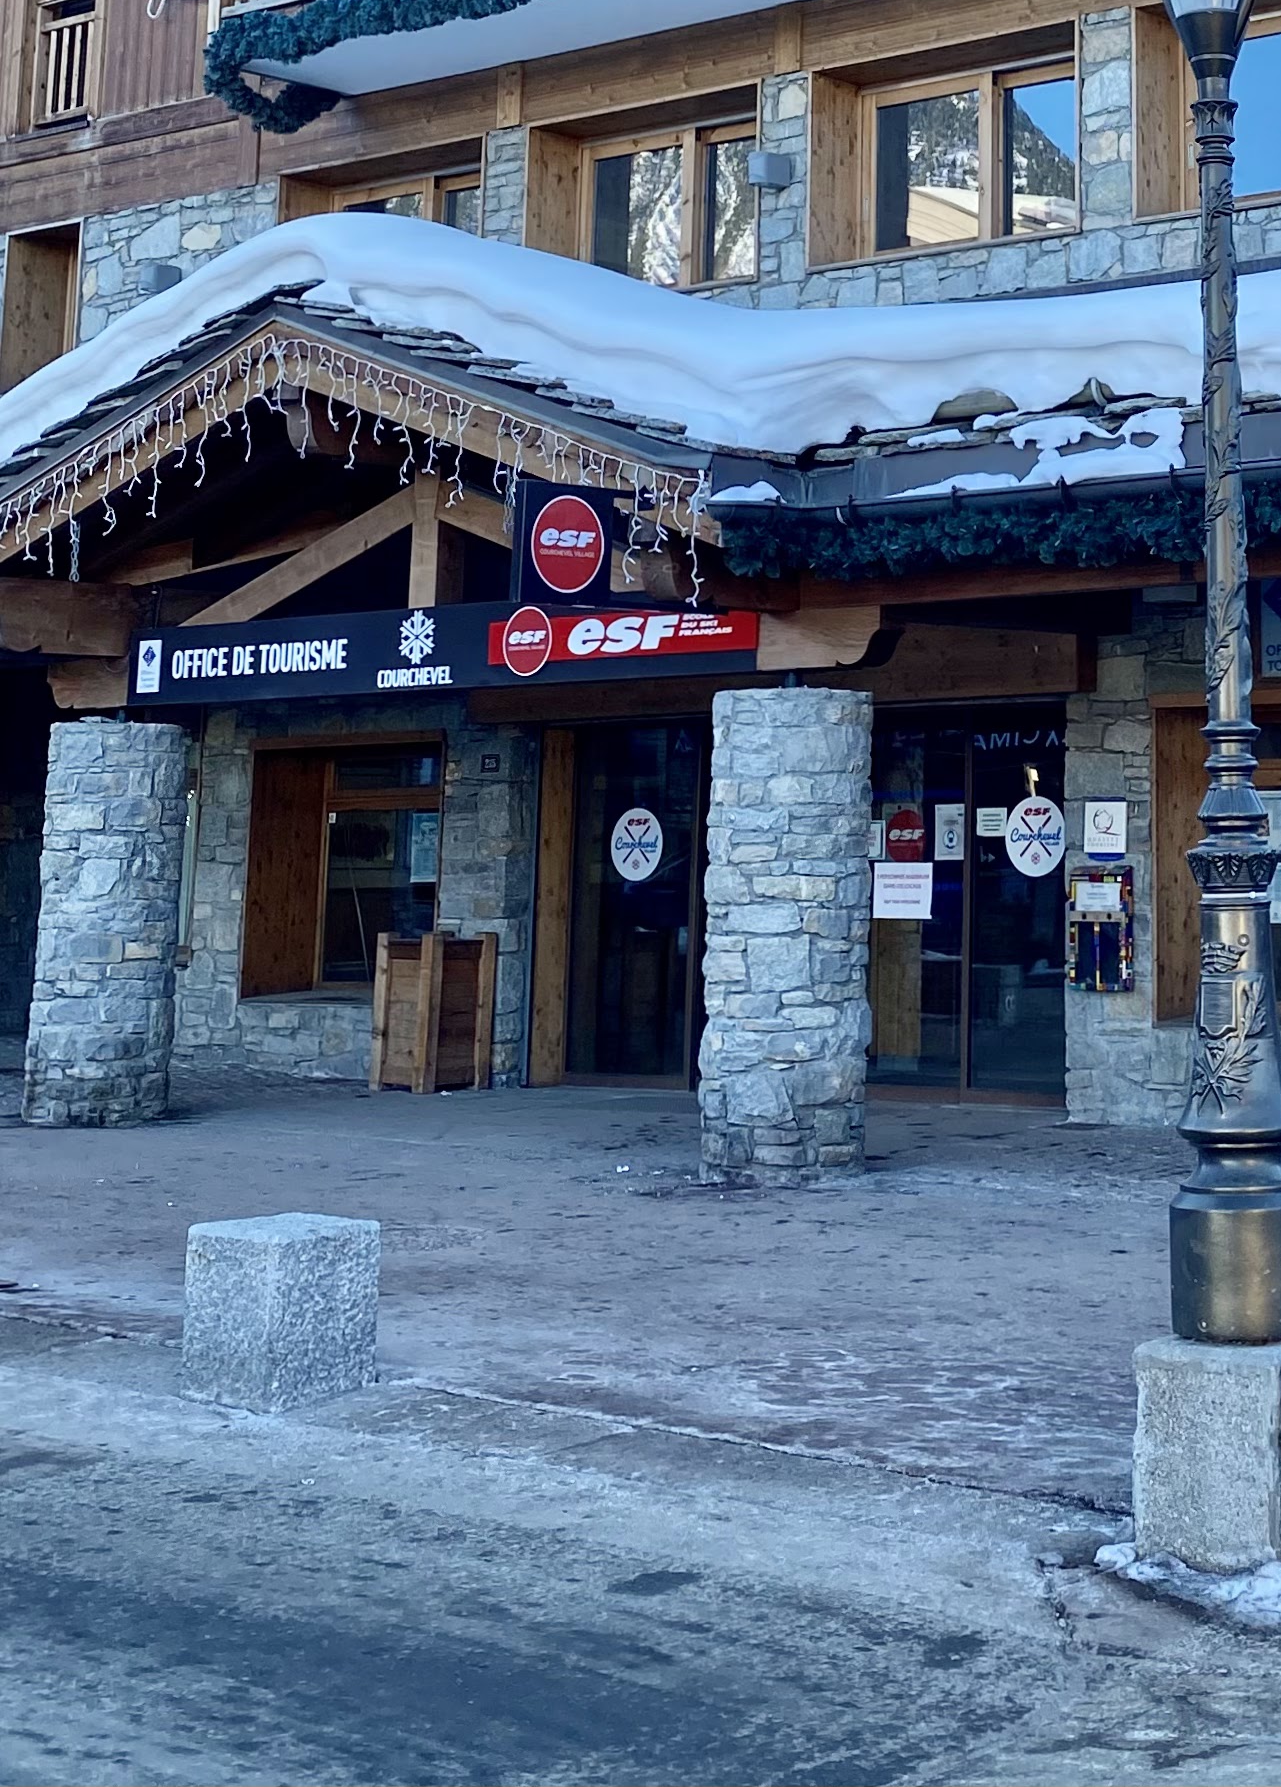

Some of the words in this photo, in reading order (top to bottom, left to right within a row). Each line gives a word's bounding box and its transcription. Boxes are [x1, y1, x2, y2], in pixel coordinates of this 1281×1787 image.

[678, 626, 733, 637] FRANÇAIS
[680, 621, 698, 629] DU
[699, 619, 719, 628] SKI
[171, 647, 229, 680] OFFICE
[232, 645, 255, 677] DE
[259, 638, 349, 674] TOURISME
[376, 665, 454, 689] COURCHEVEL
[1010, 826, 1061, 843] Courchevel
